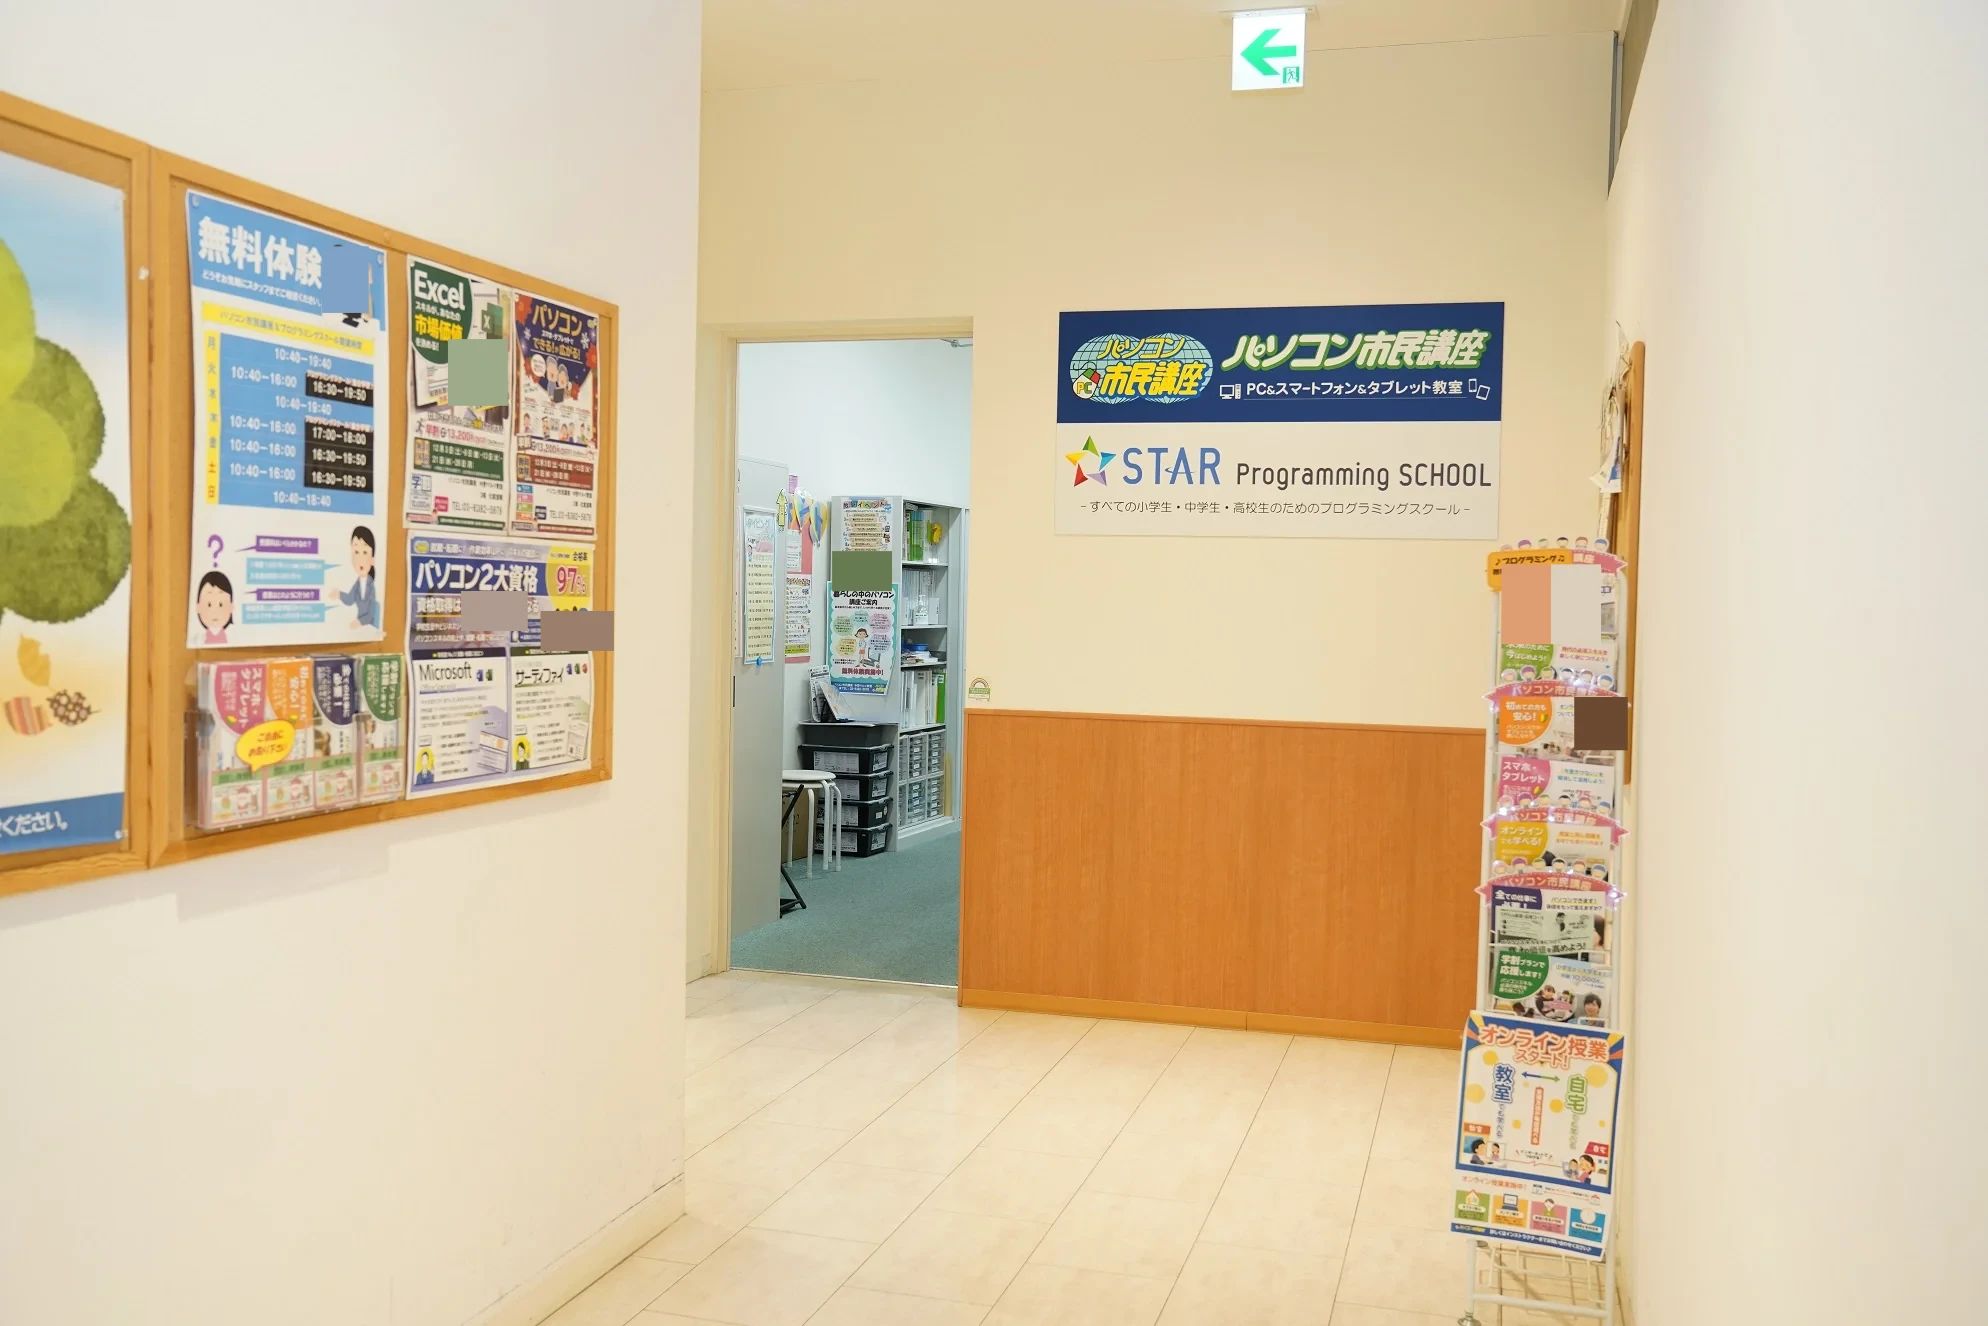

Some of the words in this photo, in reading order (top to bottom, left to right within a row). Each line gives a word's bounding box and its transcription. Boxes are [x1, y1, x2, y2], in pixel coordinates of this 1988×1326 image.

[198, 215, 323, 290] 無料体験
[414, 269, 466, 310] Excel
[532, 305, 583, 337] パソコン
[1097, 336, 1185, 360] パソコン
[1220, 328, 1491, 371] パソコン市民講座
[1076, 381, 1093, 395] PC
[1100, 360, 1206, 397] 市民講座
[1122, 446, 1221, 485] STAR
[1236, 461, 1389, 491] Programming
[1398, 463, 1492, 487] SCHOOL
[415, 559, 538, 594] パソコン2大資格
[556, 565, 587, 594] 97%
[419, 661, 473, 682] Microsoft
[1501, 771, 1545, 784] タブレット
[0, 811, 69, 838] ください。
[1479, 1025, 1609, 1061] オンライン授業
[1515, 1048, 1571, 1069] スタート!
[1492, 1062, 1515, 1104] 教室
[1565, 1074, 1588, 1114] 自宅
